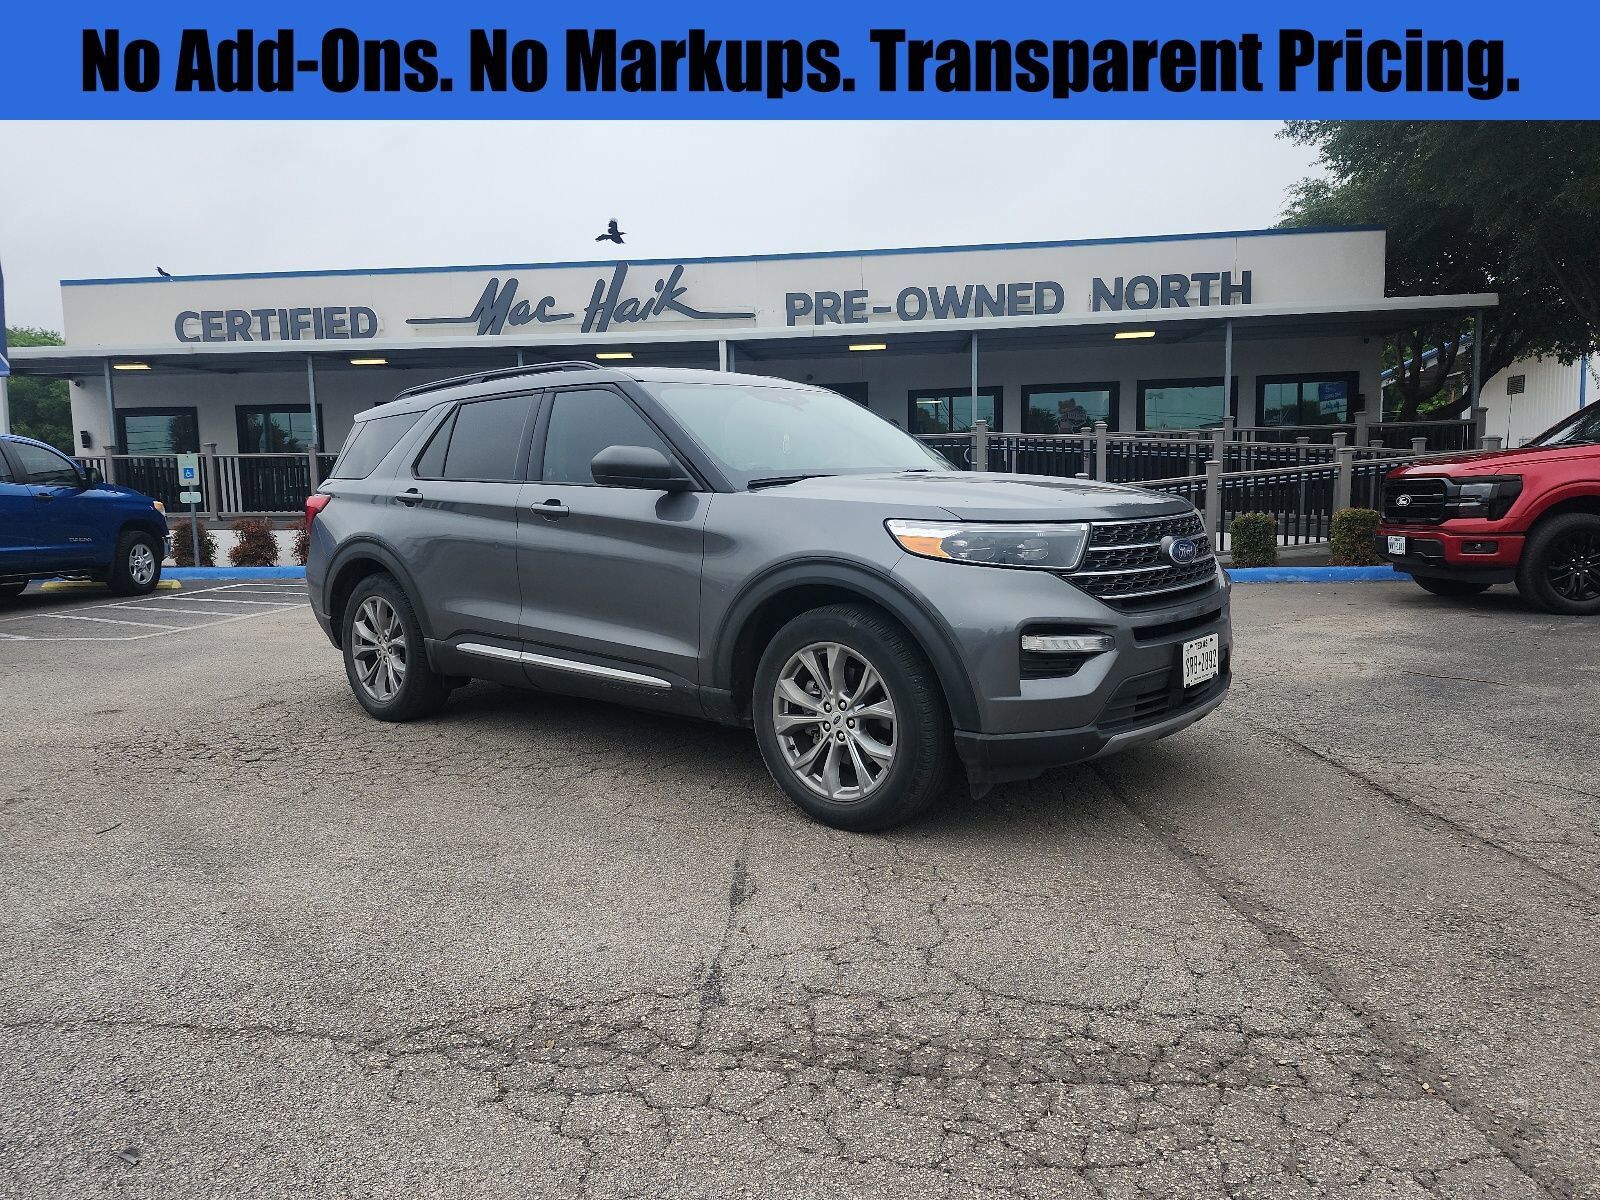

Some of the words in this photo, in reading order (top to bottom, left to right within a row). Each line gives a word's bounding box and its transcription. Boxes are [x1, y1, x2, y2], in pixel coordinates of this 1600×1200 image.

[175, 306, 378, 342] CERTIFIED
[406, 277, 575, 335] Mac
[580, 261, 756, 334] Haik
[785, 281, 1065, 326] PRE-OWNED
[1092, 270, 1252, 312] NORTH
